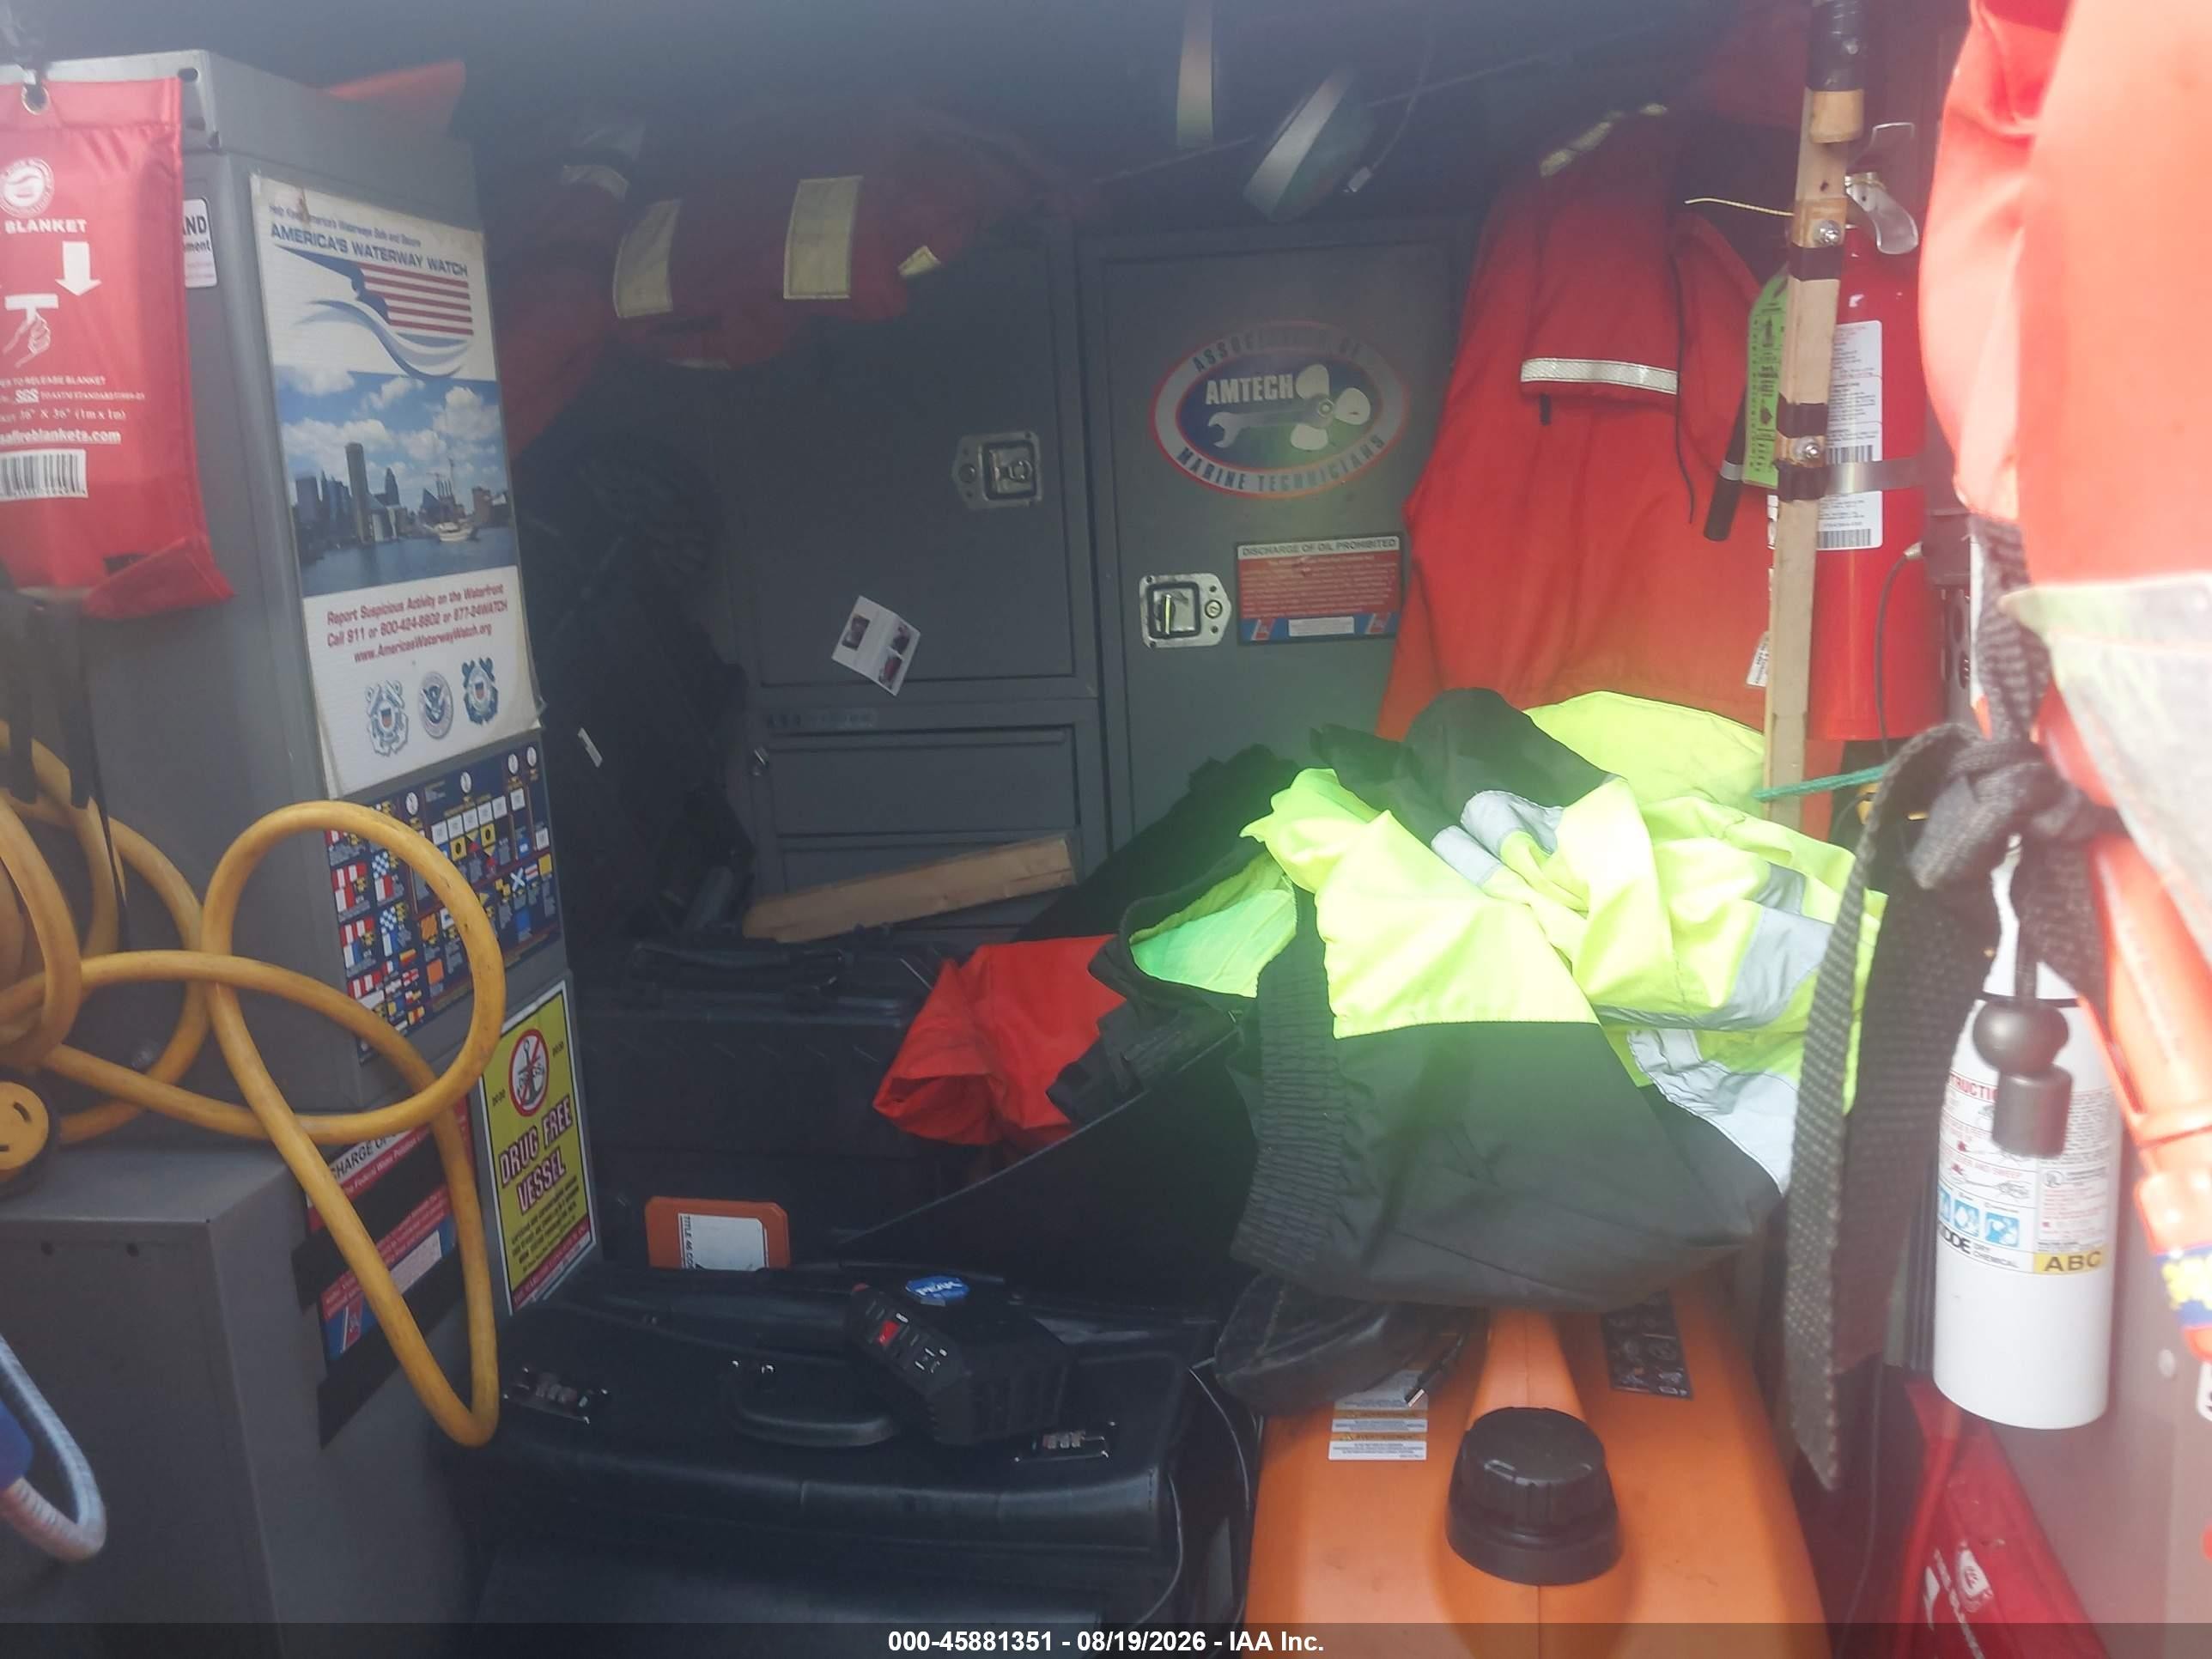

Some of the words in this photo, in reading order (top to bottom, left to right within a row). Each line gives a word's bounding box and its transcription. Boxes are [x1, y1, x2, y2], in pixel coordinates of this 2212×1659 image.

[4, 219, 87, 234] BLANKET
[183, 240, 210, 252] ment
[271, 223, 348, 253] AMERICA'S
[352, 241, 424, 268] WATERWAY
[428, 258, 468, 276] WATCH
[1206, 374, 1293, 405] AMTECH
[1177, 446, 1247, 490] MARINE
[1258, 433, 1385, 492] TECHNICIANS
[1243, 544, 1298, 556] DISCHARGE
[1302, 544, 1315, 552] OF
[1317, 542, 1332, 552] OIL
[1336, 538, 1396, 550] PROHIBITED
[327, 610, 358, 626] Report
[361, 601, 404, 620] Suspicious
[408, 595, 434, 611] Activity
[327, 632, 345, 648] Call
[348, 627, 366, 644] 911
[368, 628, 379, 639] or
[501, 1126, 539, 1188] DRUG
[544, 1094, 573, 1151] FREE
[517, 1147, 567, 1214] VESSEL
[684, 1215, 692, 1237] TITLE
[2045, 1251, 2101, 1272] ABC
